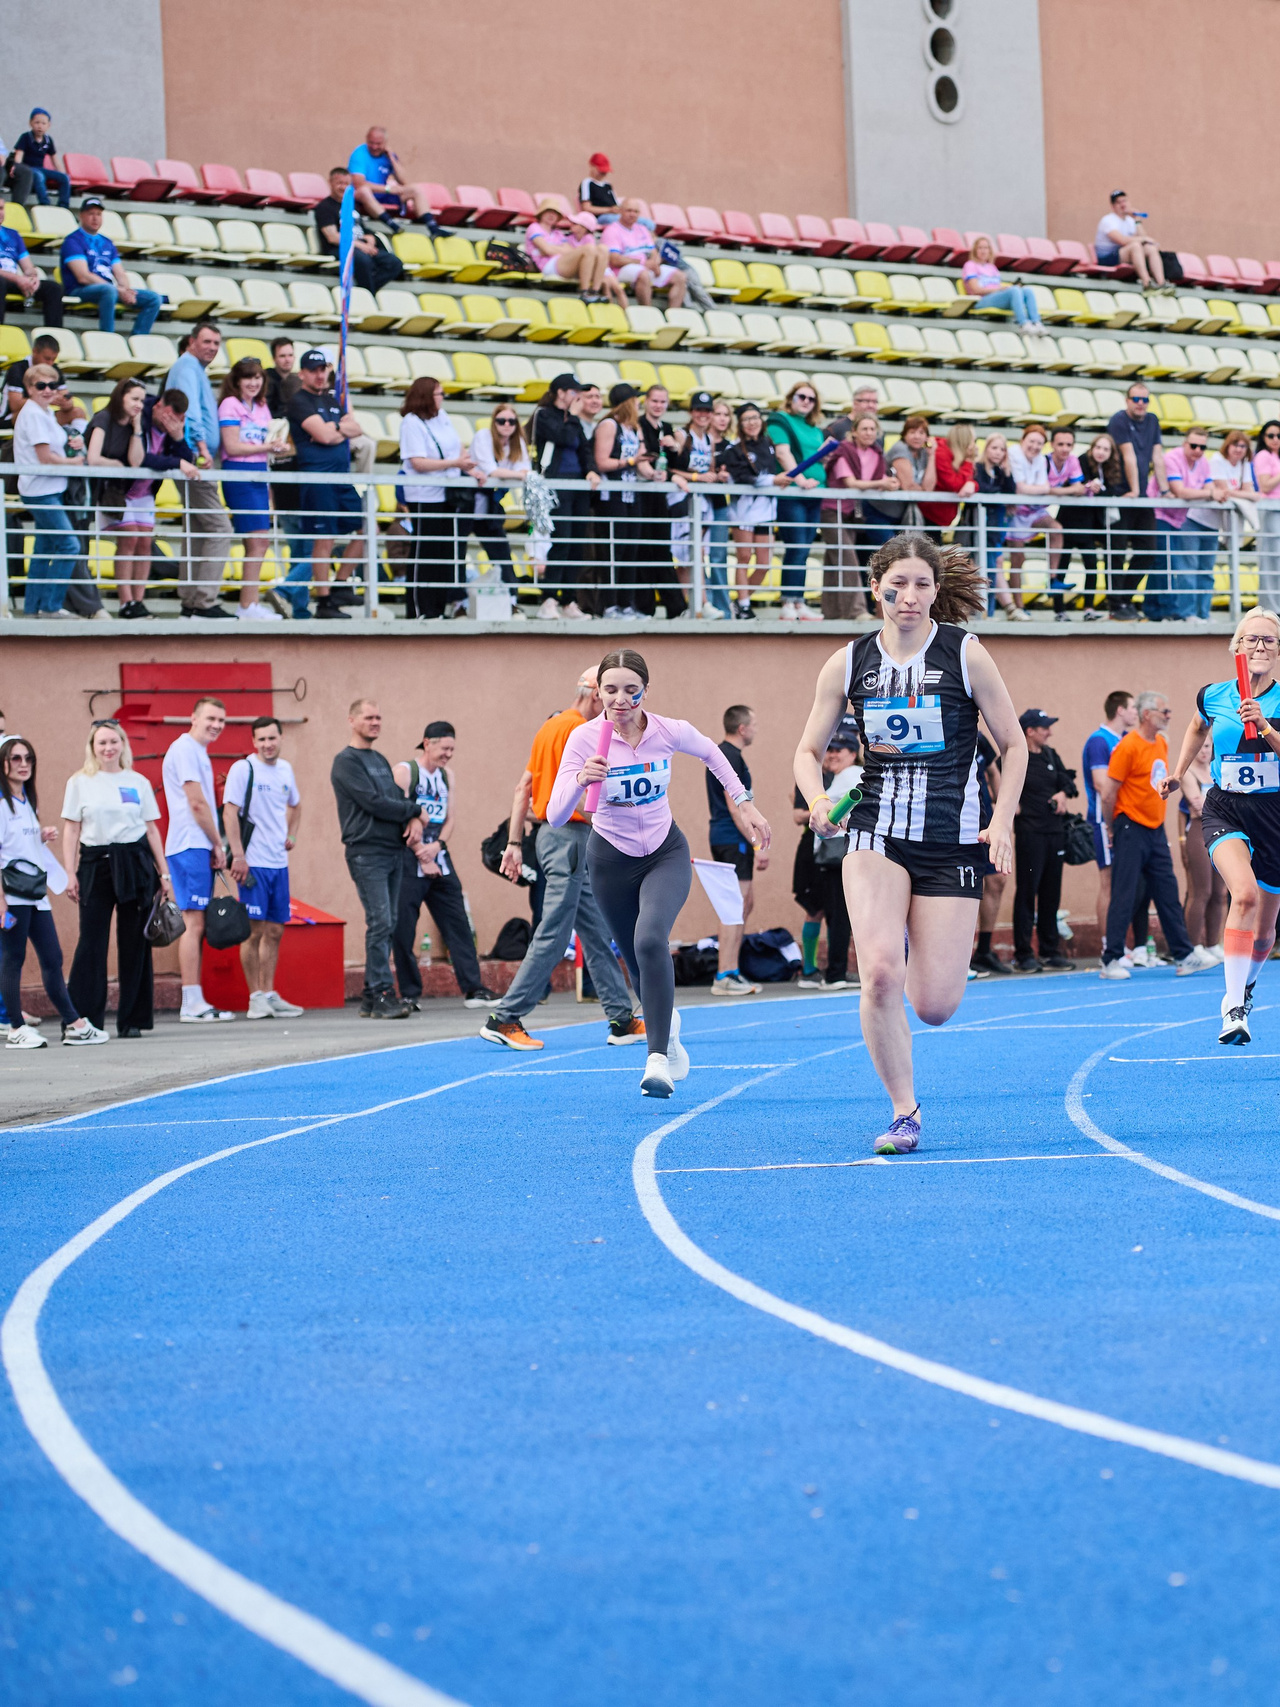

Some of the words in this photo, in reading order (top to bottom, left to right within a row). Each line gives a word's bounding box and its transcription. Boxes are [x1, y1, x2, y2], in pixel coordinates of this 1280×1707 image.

[886, 714, 910, 741] 9
[1238, 766, 1256, 786] 8
[620, 777, 652, 799] 10
[956, 866, 975, 888] 17
